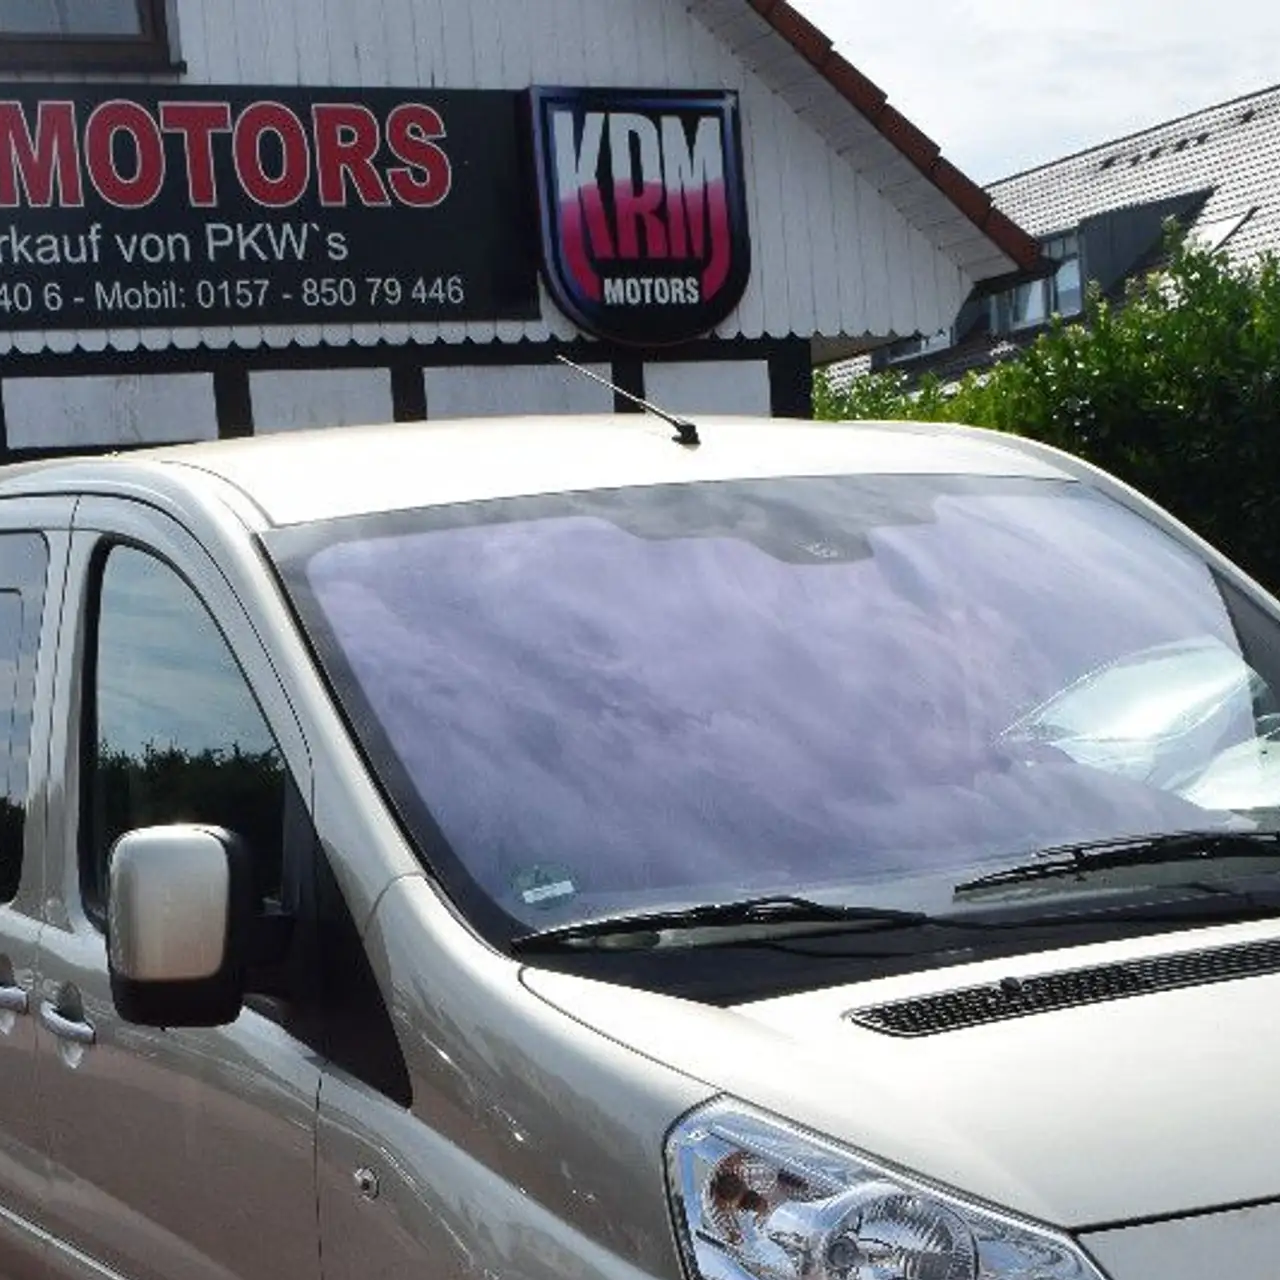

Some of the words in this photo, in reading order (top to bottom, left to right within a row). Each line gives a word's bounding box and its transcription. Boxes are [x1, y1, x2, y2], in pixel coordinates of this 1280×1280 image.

[551, 111, 731, 299] KRM
[116, 232, 191, 264] von
[43, 283, 64, 312] 6
[96, 281, 186, 311] Mobil:
[196, 279, 269, 309] 0157
[302, 278, 355, 308] 850
[366, 277, 402, 306] 79
[411, 276, 465, 305] 446
[603, 277, 700, 304] MOTORS
